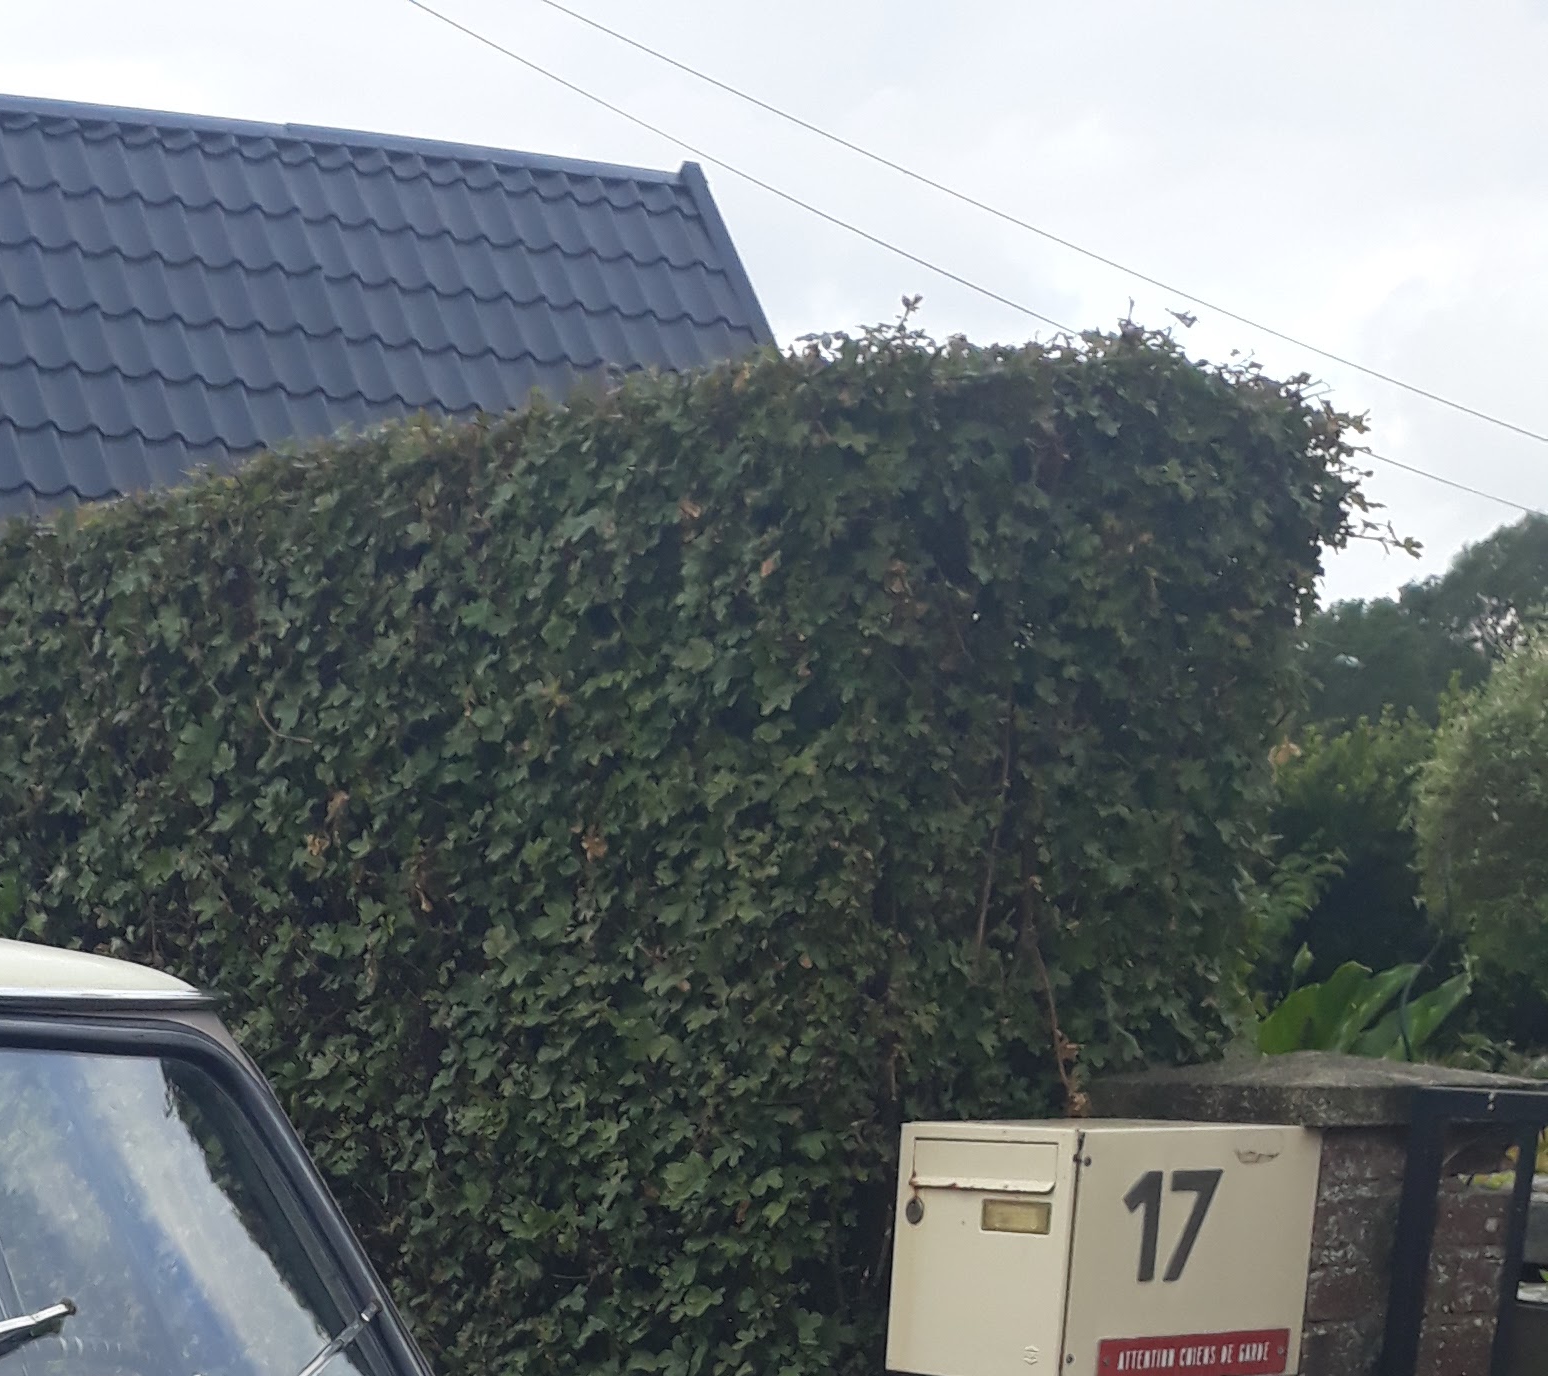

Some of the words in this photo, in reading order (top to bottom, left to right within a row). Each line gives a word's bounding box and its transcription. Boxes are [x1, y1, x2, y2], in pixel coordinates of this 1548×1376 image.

[1123, 1169, 1224, 1283] 17
[1117, 1348, 1175, 1371] ATTENTION
[1220, 1343, 1233, 1365] DE
[1238, 1341, 1270, 1363] GARDE
